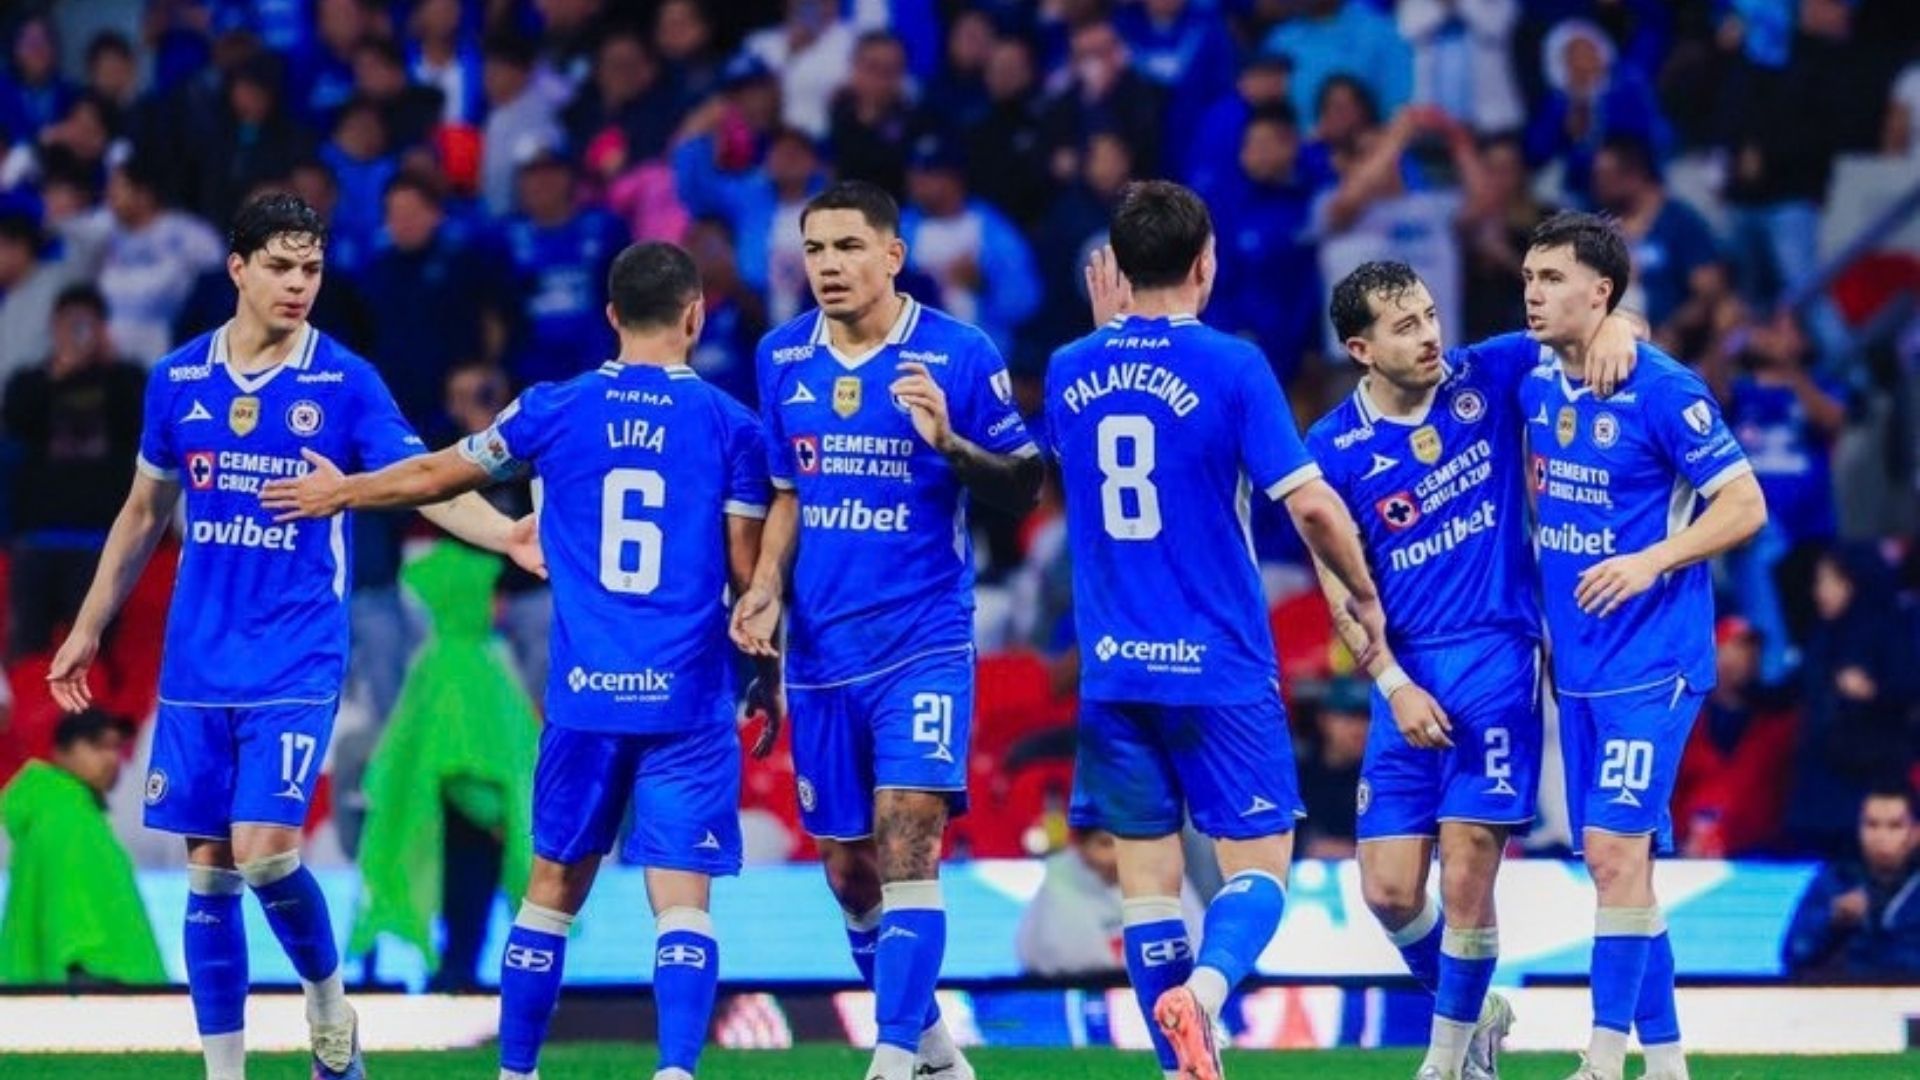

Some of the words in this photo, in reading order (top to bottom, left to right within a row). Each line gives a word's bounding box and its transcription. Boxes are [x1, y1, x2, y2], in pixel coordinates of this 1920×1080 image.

[1105, 336, 1171, 349] PIRMA
[606, 389, 673, 406] PIRMA
[1063, 363, 1200, 417] PALAVECINO
[606, 419, 665, 454] LIRA
[822, 434, 913, 457] CEMENTO
[219, 451, 308, 477] CEMENTO
[821, 456, 863, 475] CRUZ
[867, 459, 912, 478] AZUL
[1098, 415, 1162, 540] 8
[1415, 439, 1491, 498] CEMENTO
[1550, 459, 1609, 487] CEMENTO
[217, 473, 259, 494] CRUZ
[192, 514, 299, 551] ovibet
[600, 468, 666, 595] 6
[1390, 500, 1496, 572] novibet
[1121, 638, 1201, 663] cemix
[589, 668, 670, 692] cemix
[912, 692, 953, 746] 21
[280, 732, 316, 784] 17
[1484, 727, 1511, 778] 2
[1599, 740, 1654, 790] 20
